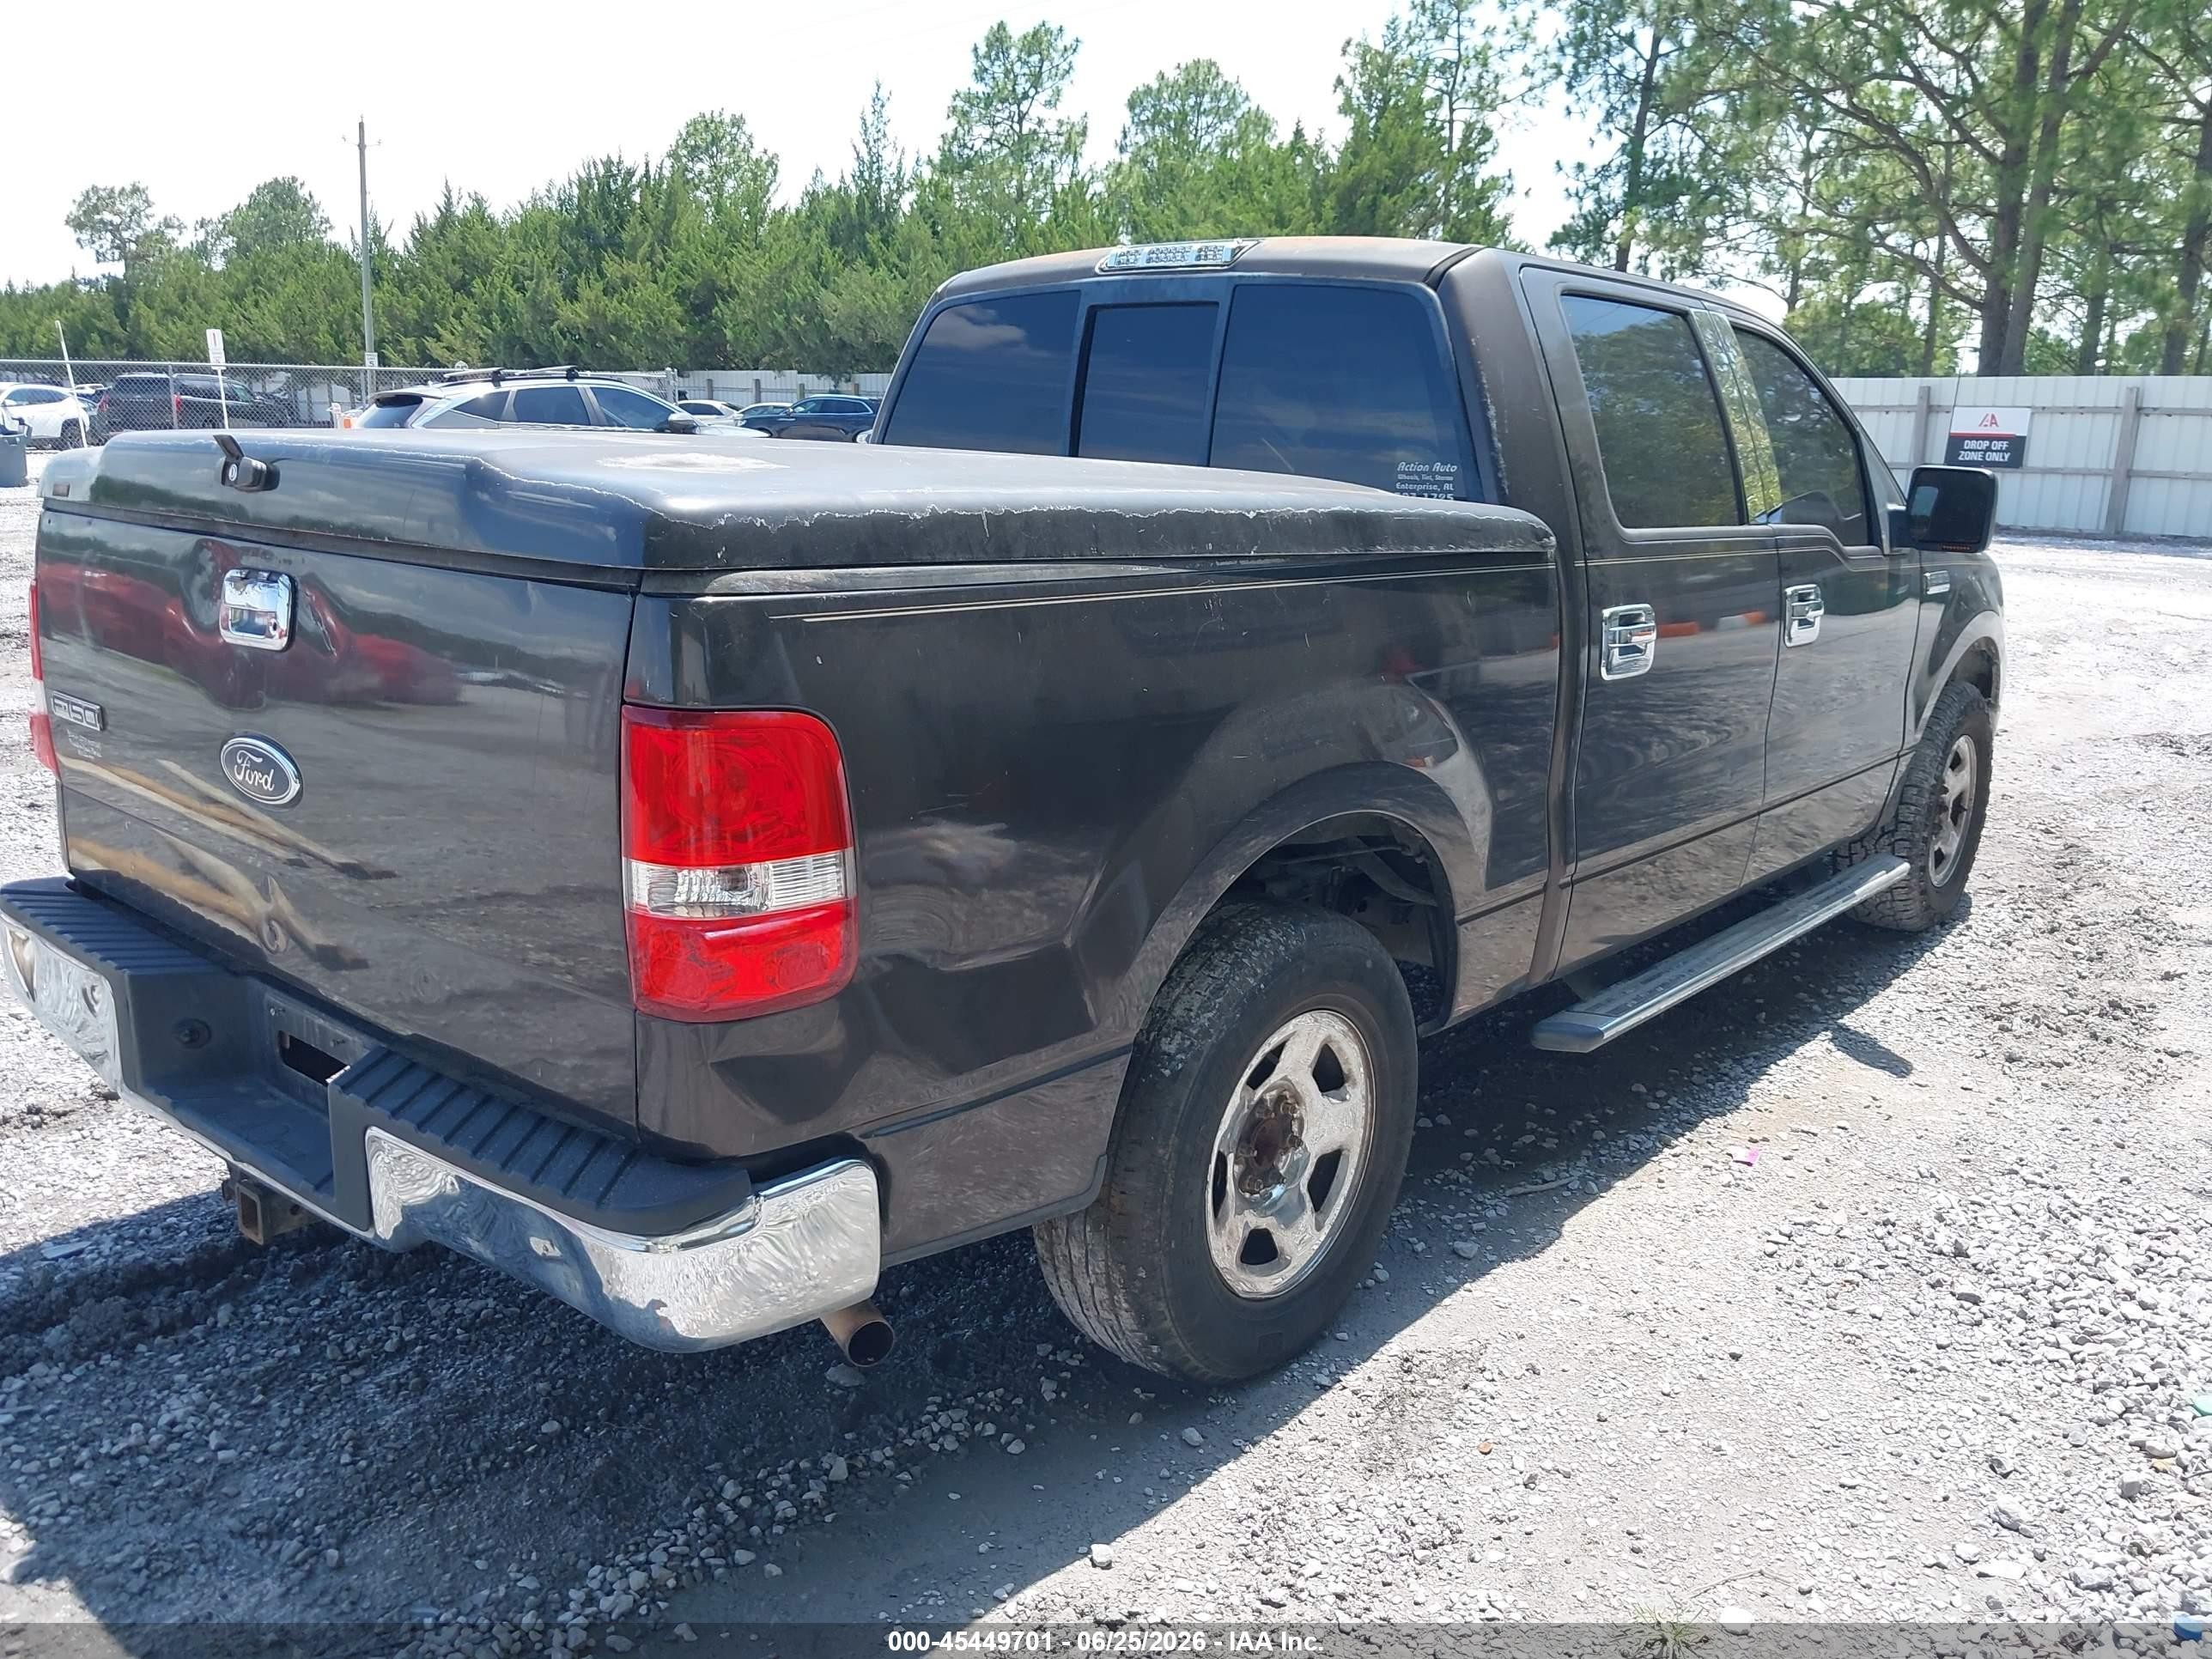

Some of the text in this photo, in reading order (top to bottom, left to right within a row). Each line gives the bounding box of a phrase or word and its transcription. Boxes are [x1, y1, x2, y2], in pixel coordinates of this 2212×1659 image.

[1964, 440, 2009, 451] DROP OFF
[1958, 451, 2011, 462] ZONE ONLY
[1397, 461, 1457, 472] Action Auto
[1395, 482, 1441, 491] Enterprise,
[234, 750, 275, 791] Ford
